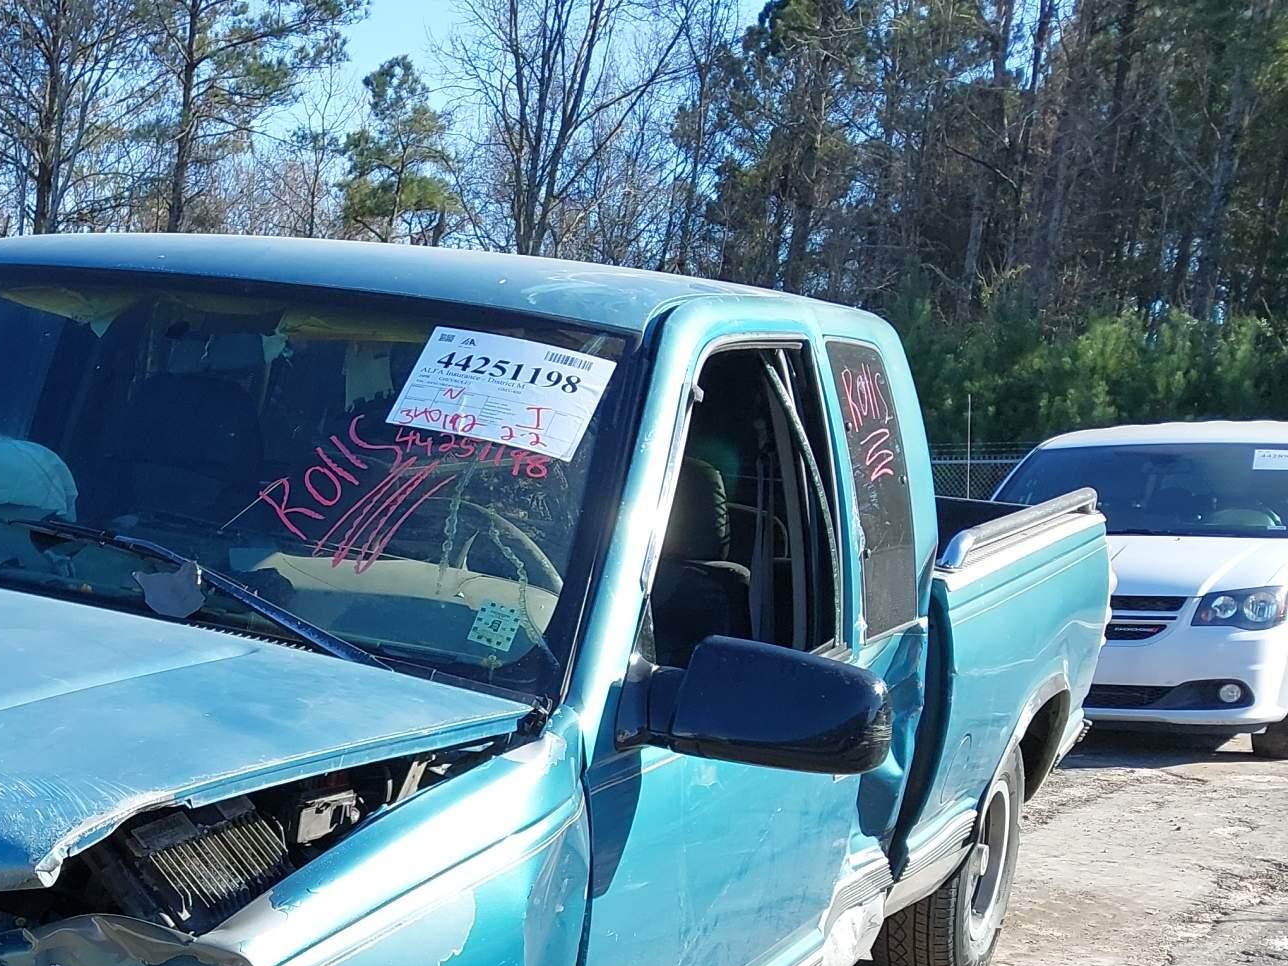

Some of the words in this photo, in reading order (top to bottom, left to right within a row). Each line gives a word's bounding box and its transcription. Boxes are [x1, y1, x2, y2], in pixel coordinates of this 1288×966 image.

[436, 351, 581, 394] 44251198
[445, 369, 481, 381] Insurance
[487, 376, 515, 388] District
